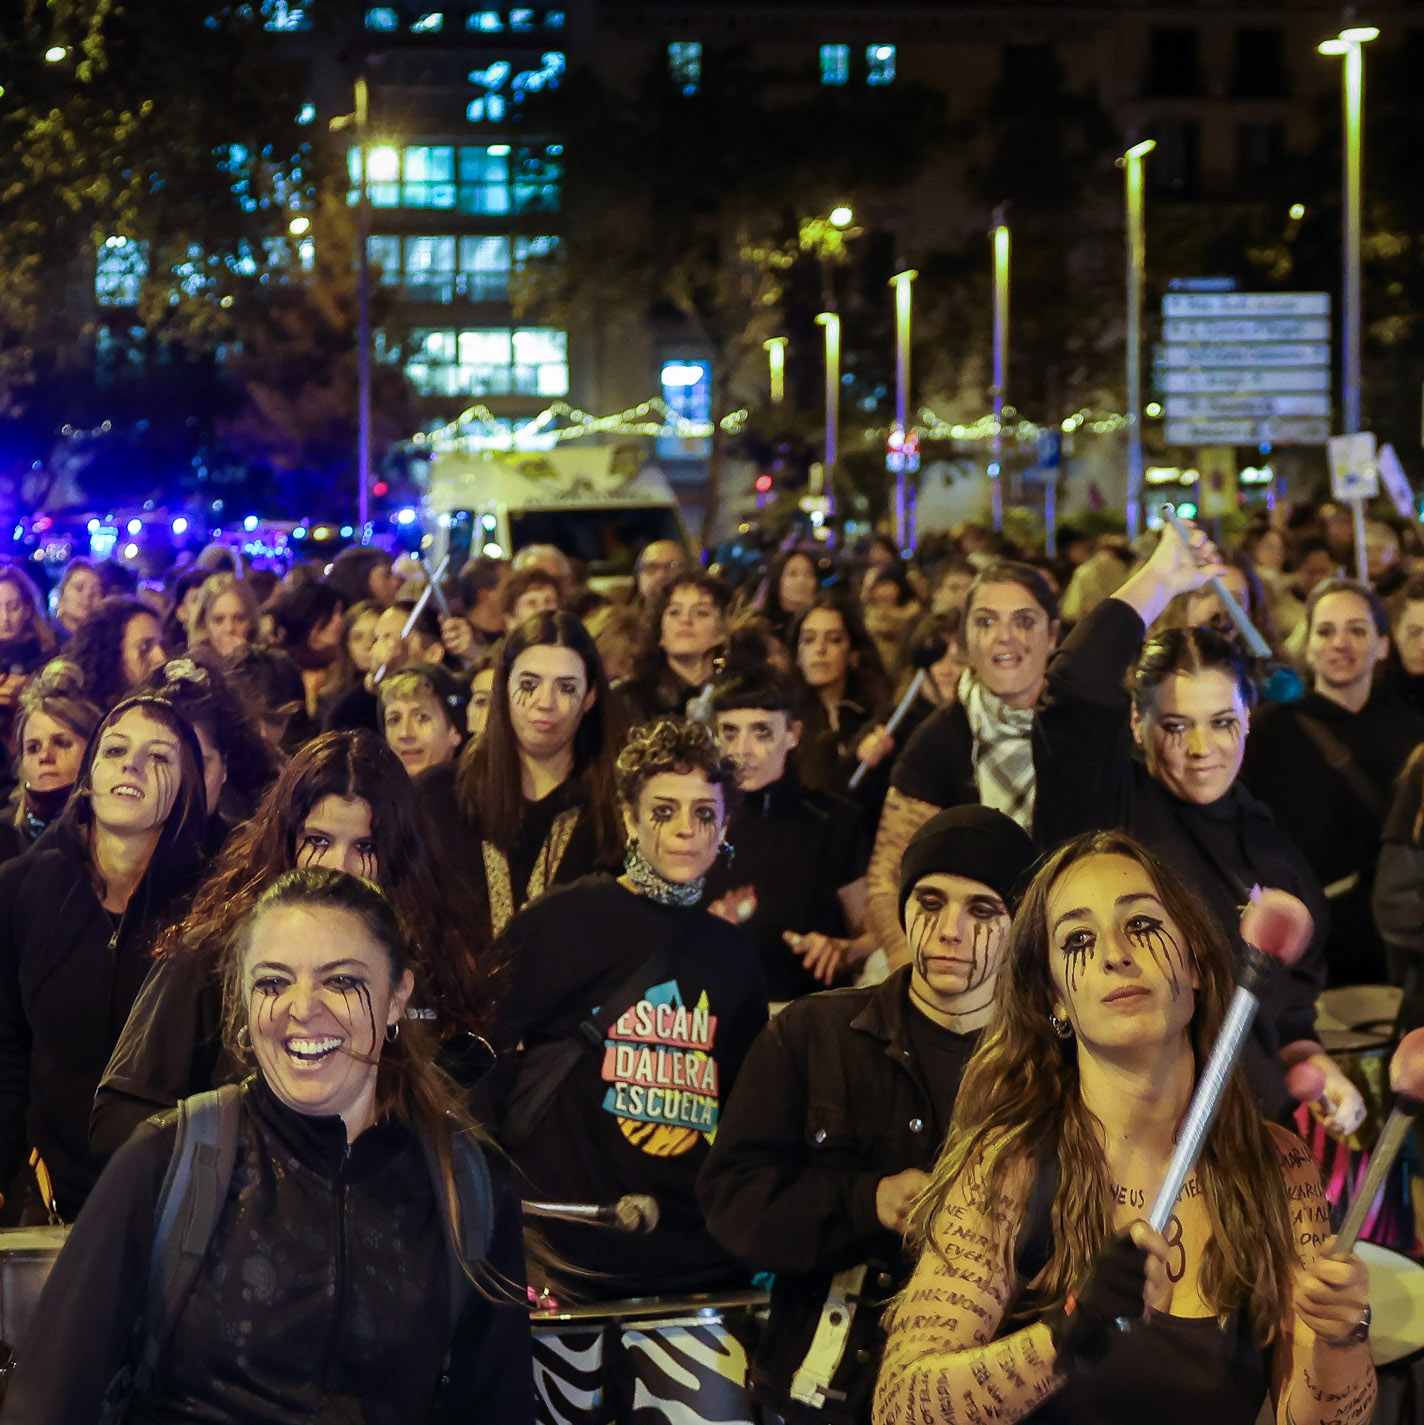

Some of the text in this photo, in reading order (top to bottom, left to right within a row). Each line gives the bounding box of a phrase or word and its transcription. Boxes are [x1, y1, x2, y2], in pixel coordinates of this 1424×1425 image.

[616, 1000, 710, 1044] ESCAN
[615, 1045, 716, 1090] DALERA
[615, 1081, 714, 1126] ESCUELA
